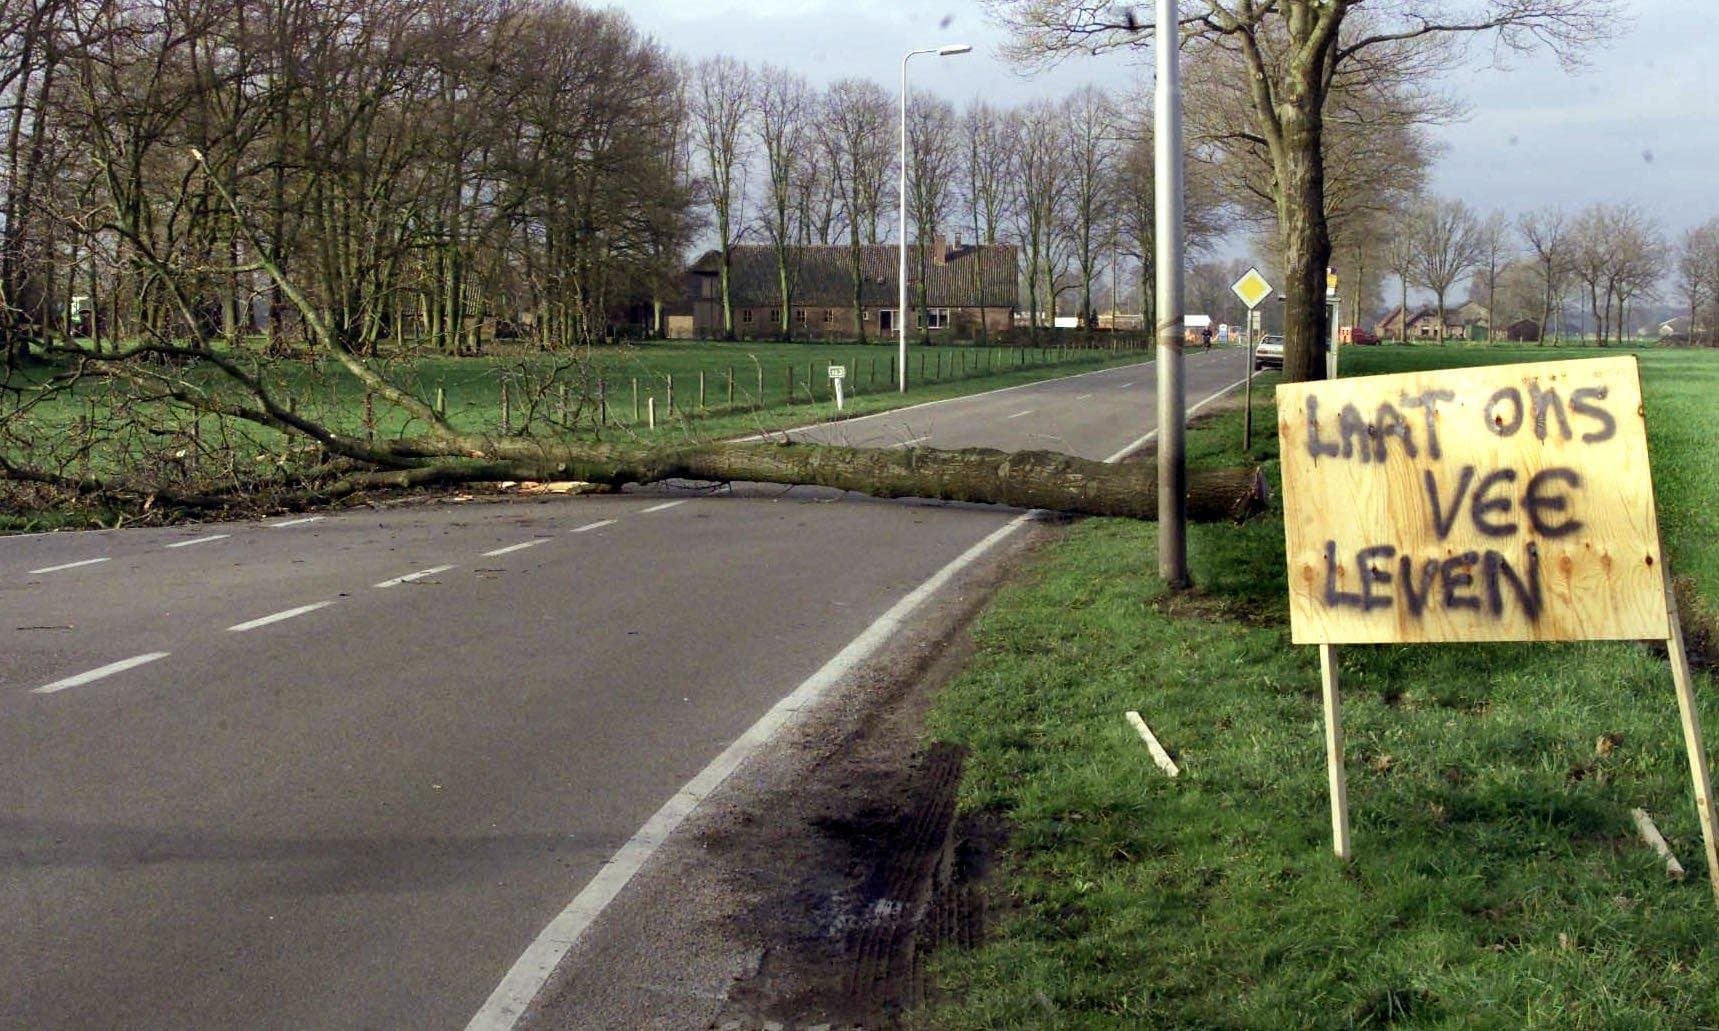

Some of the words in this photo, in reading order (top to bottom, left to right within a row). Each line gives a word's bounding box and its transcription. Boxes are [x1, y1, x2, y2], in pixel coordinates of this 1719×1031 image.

[1305, 389, 1455, 464] LAAT
[1424, 466, 1584, 541] VEE
[1322, 540, 1543, 623] LEVEN
